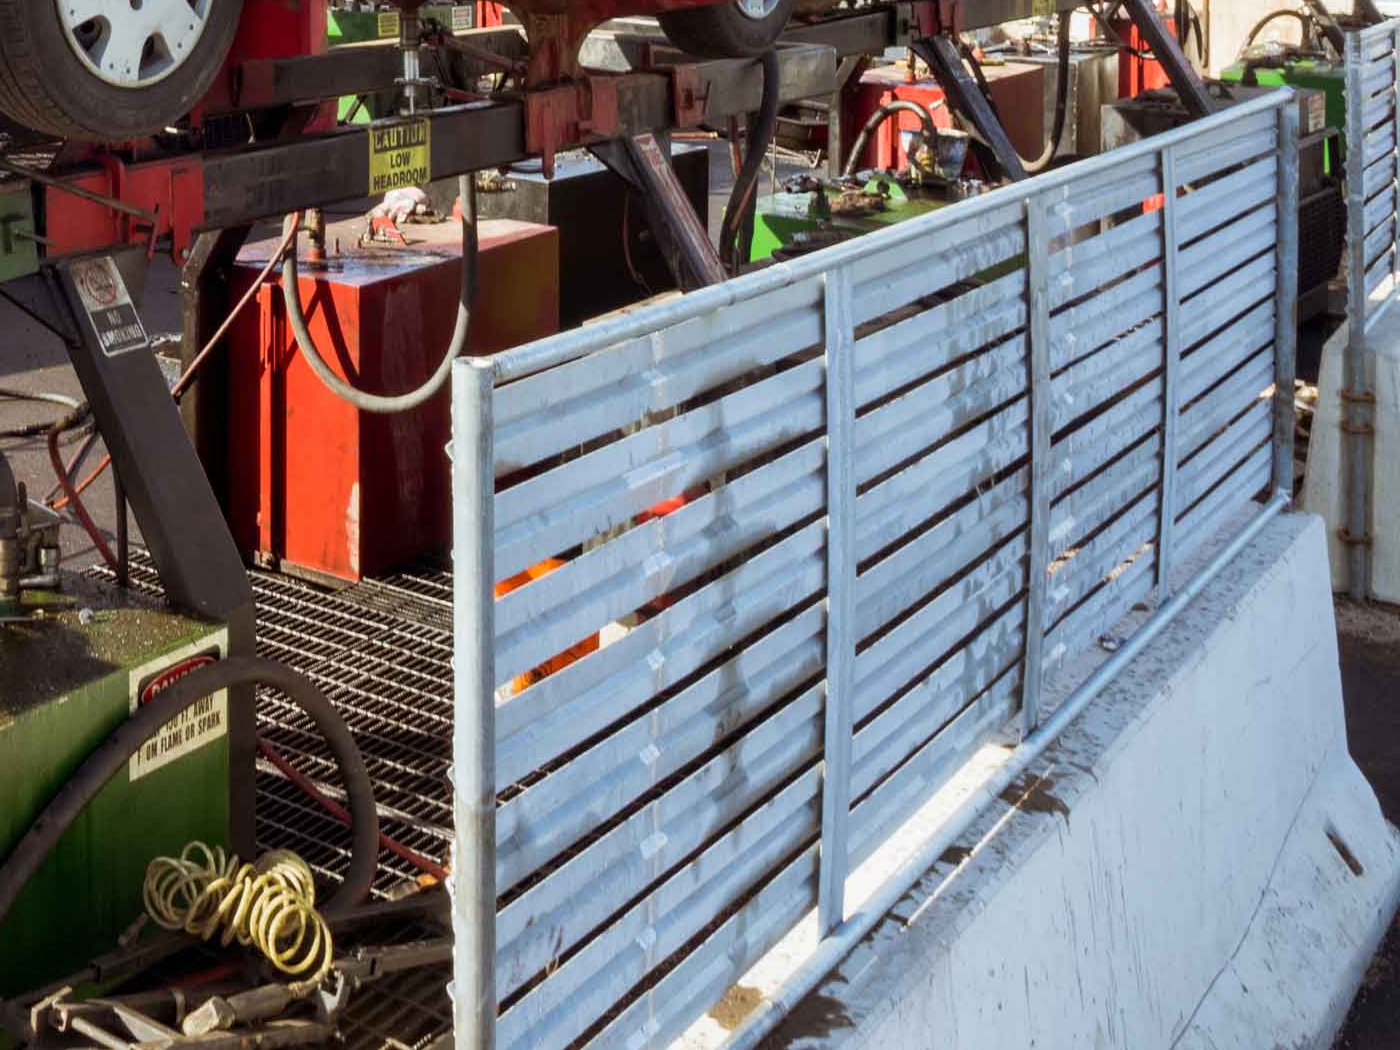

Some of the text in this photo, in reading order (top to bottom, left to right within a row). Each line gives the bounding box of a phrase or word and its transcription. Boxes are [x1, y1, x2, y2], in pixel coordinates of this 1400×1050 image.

[374, 122, 426, 150] CAUTION
[390, 152, 411, 169] LOW
[373, 167, 428, 191] HEADROOM
[106, 310, 122, 327] NO
[102, 324, 143, 348] SMOKING
[194, 694, 214, 719] AWAY
[161, 728, 183, 754] FLAME
[185, 723, 196, 742] OR
[198, 709, 221, 735] SPARK
